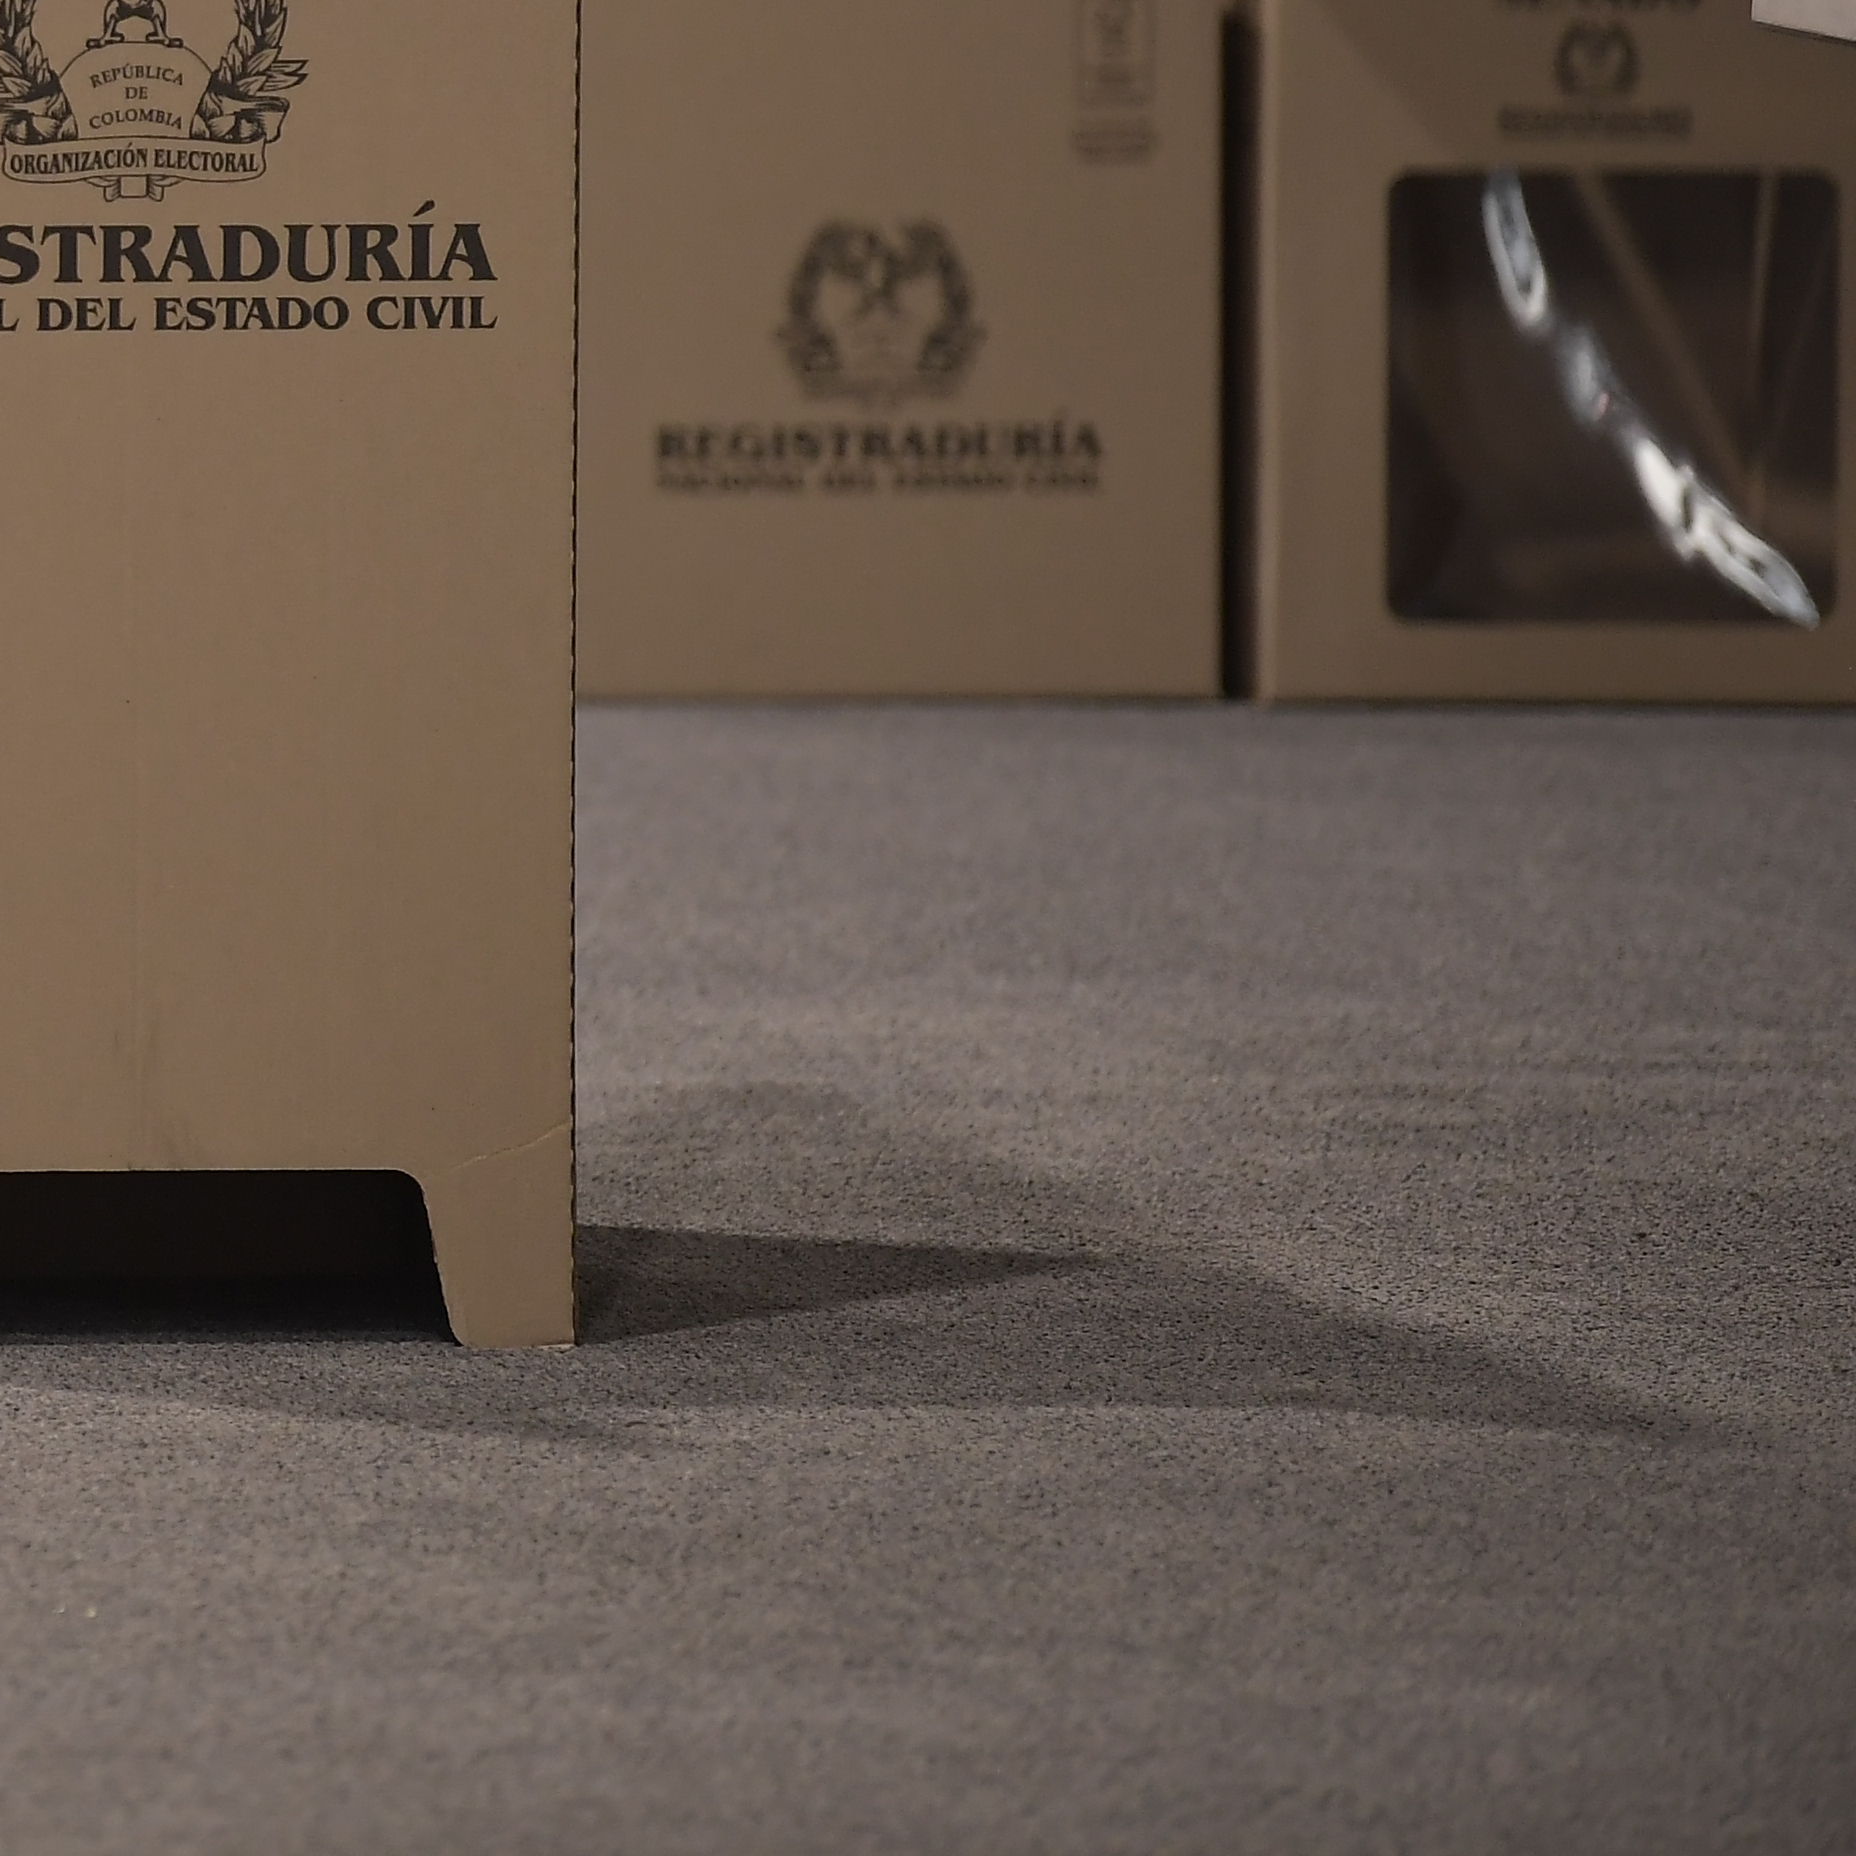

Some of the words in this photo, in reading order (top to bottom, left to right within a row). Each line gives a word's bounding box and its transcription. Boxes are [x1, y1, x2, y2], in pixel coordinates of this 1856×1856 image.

[89, 63, 184, 89] REPÚBLICA
[124, 86, 148, 100] DE
[88, 108, 183, 130] COLOMBIA
[9, 142, 148, 174] ORGANIZACIÓN
[153, 147, 259, 174] ELECTORAL
[36, 297, 137, 332] DEL
[154, 296, 350, 331] ESTADO
[366, 295, 499, 330] CIVIL
